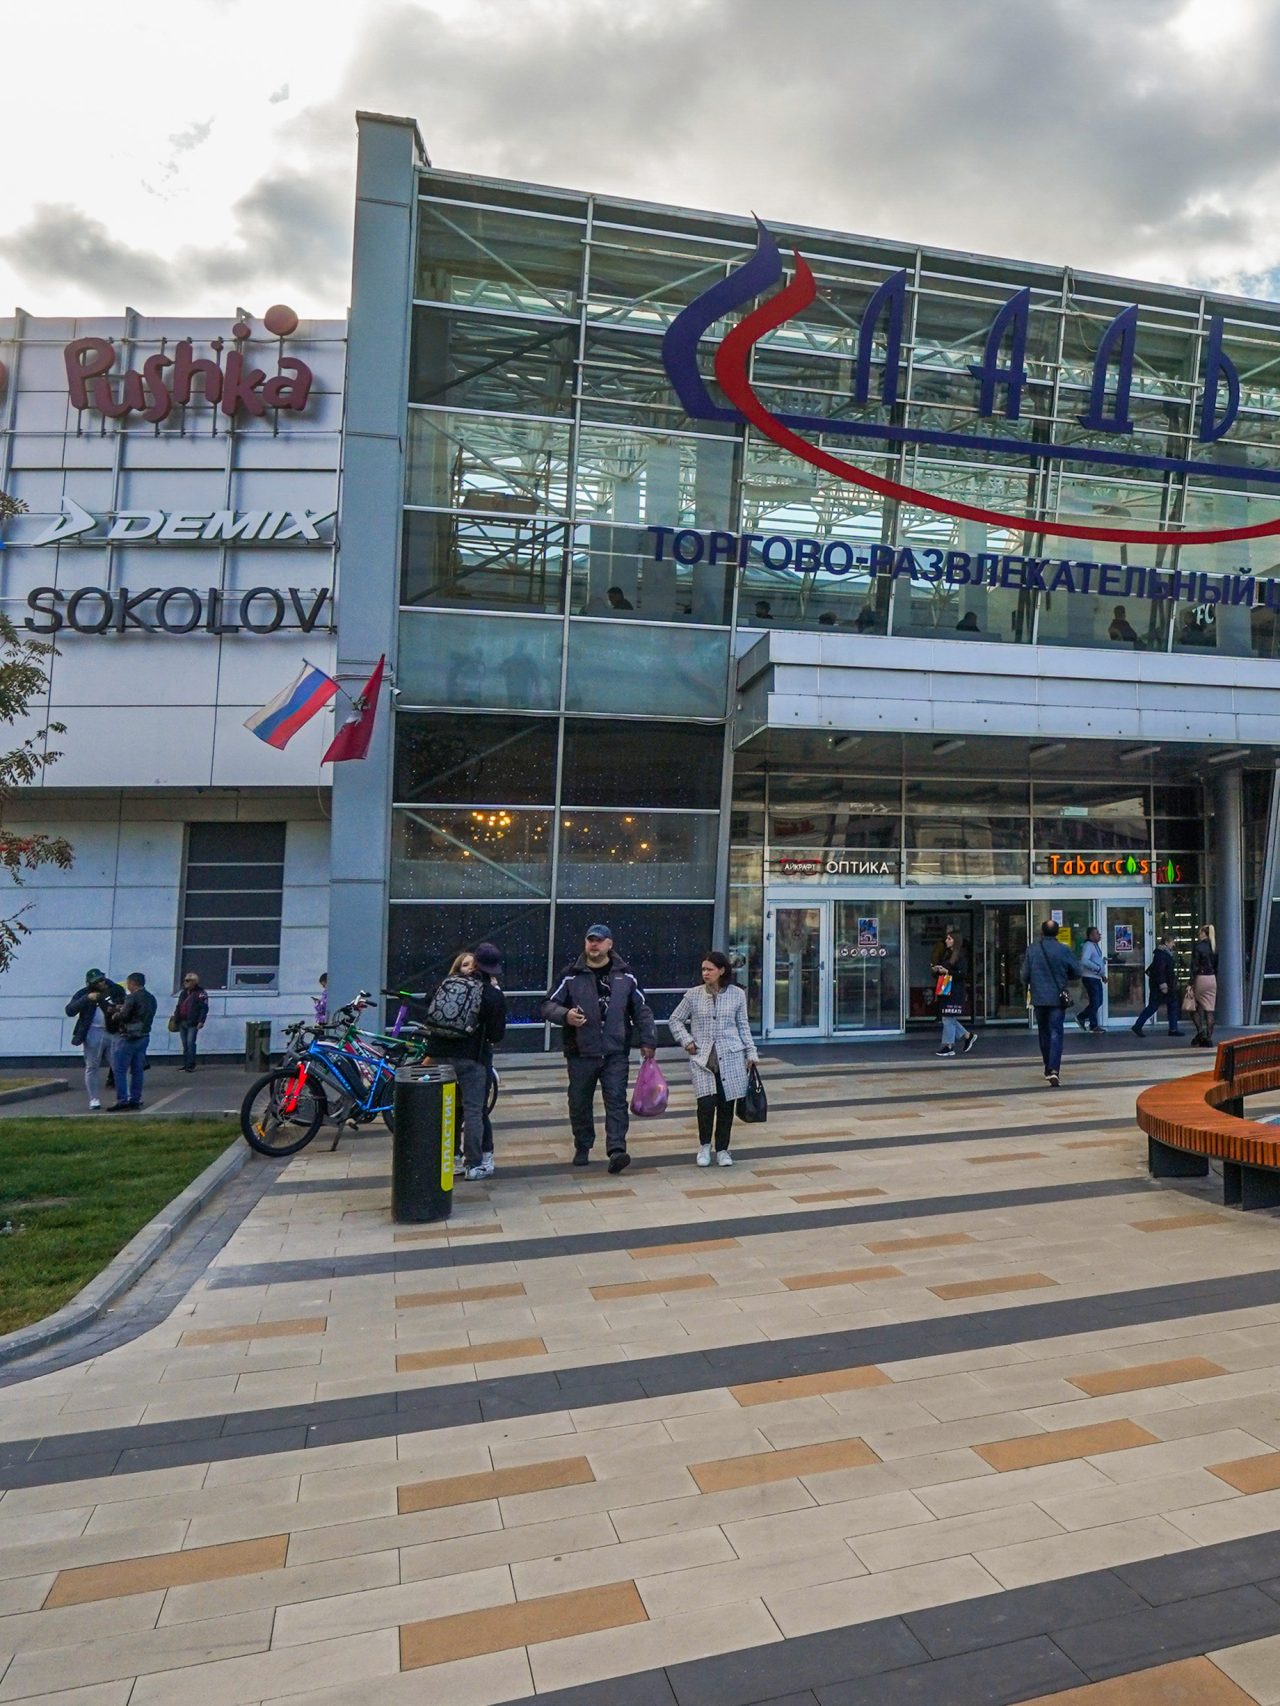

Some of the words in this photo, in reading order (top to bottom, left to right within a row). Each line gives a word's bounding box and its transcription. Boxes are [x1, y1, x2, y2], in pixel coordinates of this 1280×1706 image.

[63, 334, 313, 424] Pushka
[108, 508, 338, 540] DEMIX
[647, 525, 1256, 606] ТОРГОВО-РАЗВЛЕКАТЕЛЬНЫЙ
[24, 586, 330, 635] SOKOLOV
[784, 861, 816, 871] АЙКРАФТ
[826, 860, 890, 874] ОПТИКА
[443, 1095, 453, 1173] ПЛАСТИК
